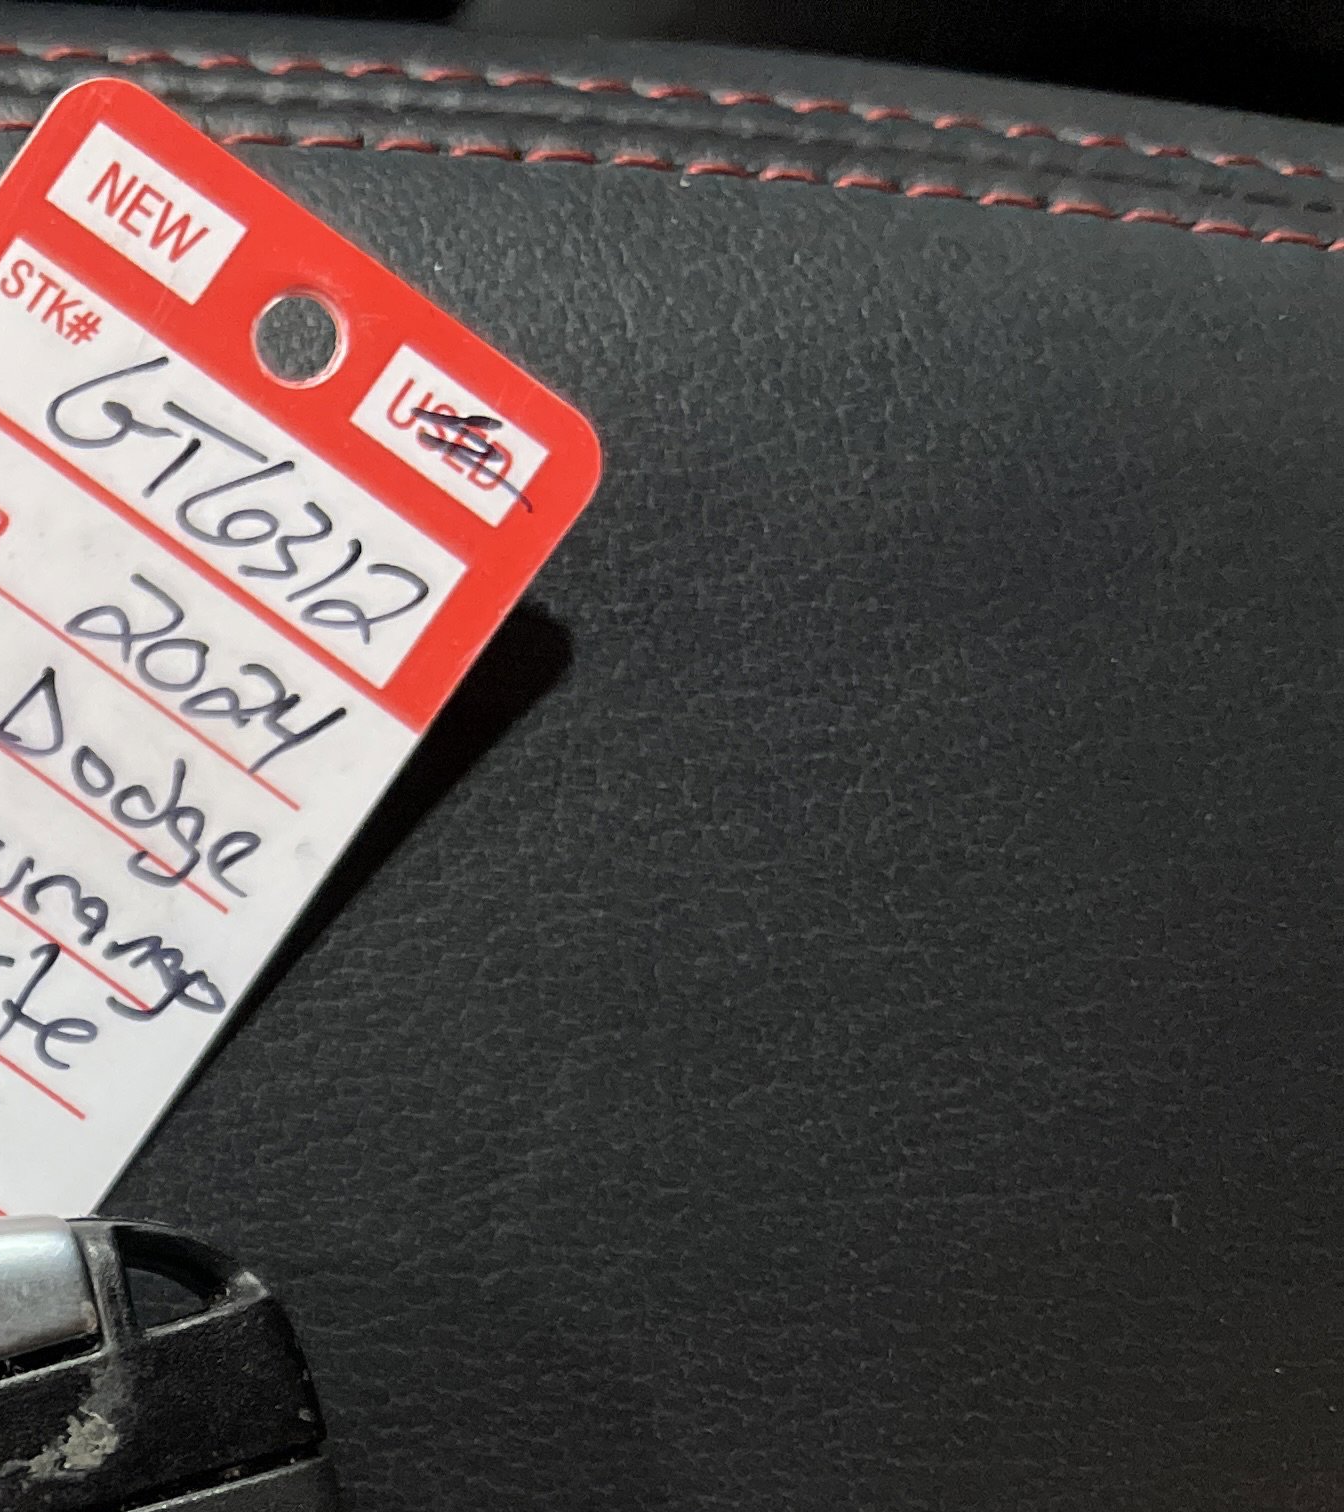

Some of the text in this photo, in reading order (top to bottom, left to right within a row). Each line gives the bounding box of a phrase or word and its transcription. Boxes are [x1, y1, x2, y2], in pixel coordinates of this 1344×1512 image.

[87, 161, 210, 263] NEW
[0, 258, 104, 345] STK#
[47, 357, 429, 644] GT6312
[66, 574, 346, 772] 2024
